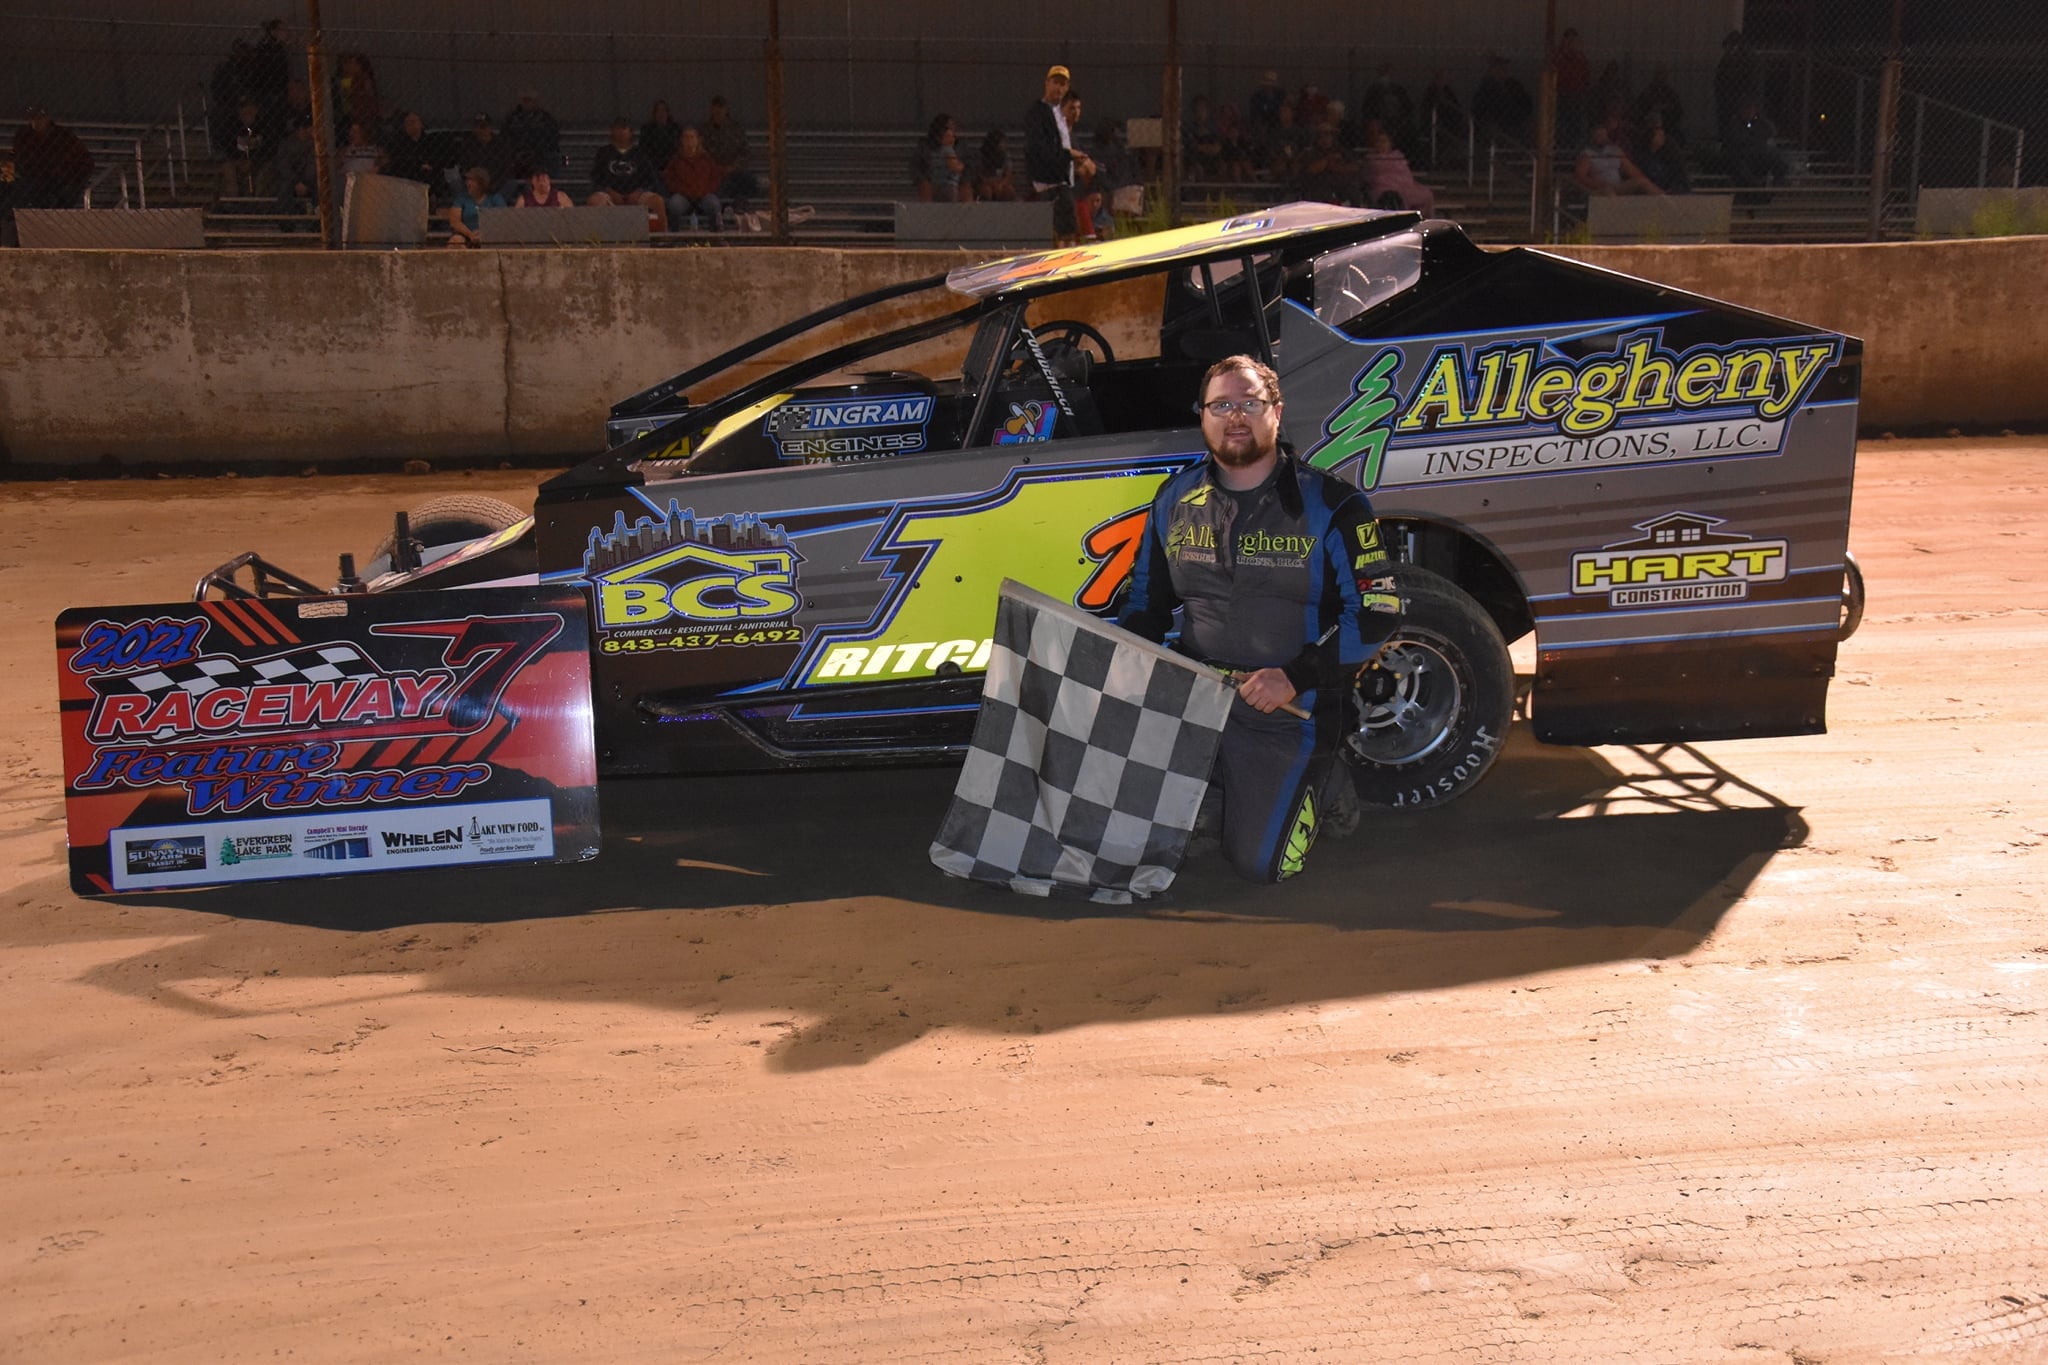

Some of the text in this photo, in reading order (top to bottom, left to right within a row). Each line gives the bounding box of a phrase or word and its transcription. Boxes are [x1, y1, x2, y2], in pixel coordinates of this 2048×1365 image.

[1398, 341, 1833, 432] Allegheny
[813, 400, 925, 427] INGRAM
[781, 432, 923, 456] ENGINES
[1422, 422, 1769, 476] INSPECTIONS, LLC.
[1577, 546, 1784, 587] HART
[601, 574, 797, 625] BCS
[1615, 583, 1743, 605] CONSTRUCTION
[603, 629, 801, 652] 843-437-6492
[613, 620, 789, 638] COMMERCIAL RESIDENTIAL JANITORIAL
[73, 622, 202, 669] 2021
[94, 613, 565, 737] RACEWAY 7
[79, 742, 336, 787] Feature
[189, 764, 489, 812] Winner
[381, 826, 464, 848] WHELEN
[497, 823, 516, 834] VIEW
[517, 821, 539, 833] FORD
[236, 834, 293, 847] EVERGREEN
[237, 846, 262, 857] LAKE
[266, 844, 293, 854] PARK
[386, 844, 464, 855] ENGINEERING COMPANY
[128, 846, 205, 863] SUNNYSIDE
[147, 860, 175, 868] TRANSIT
